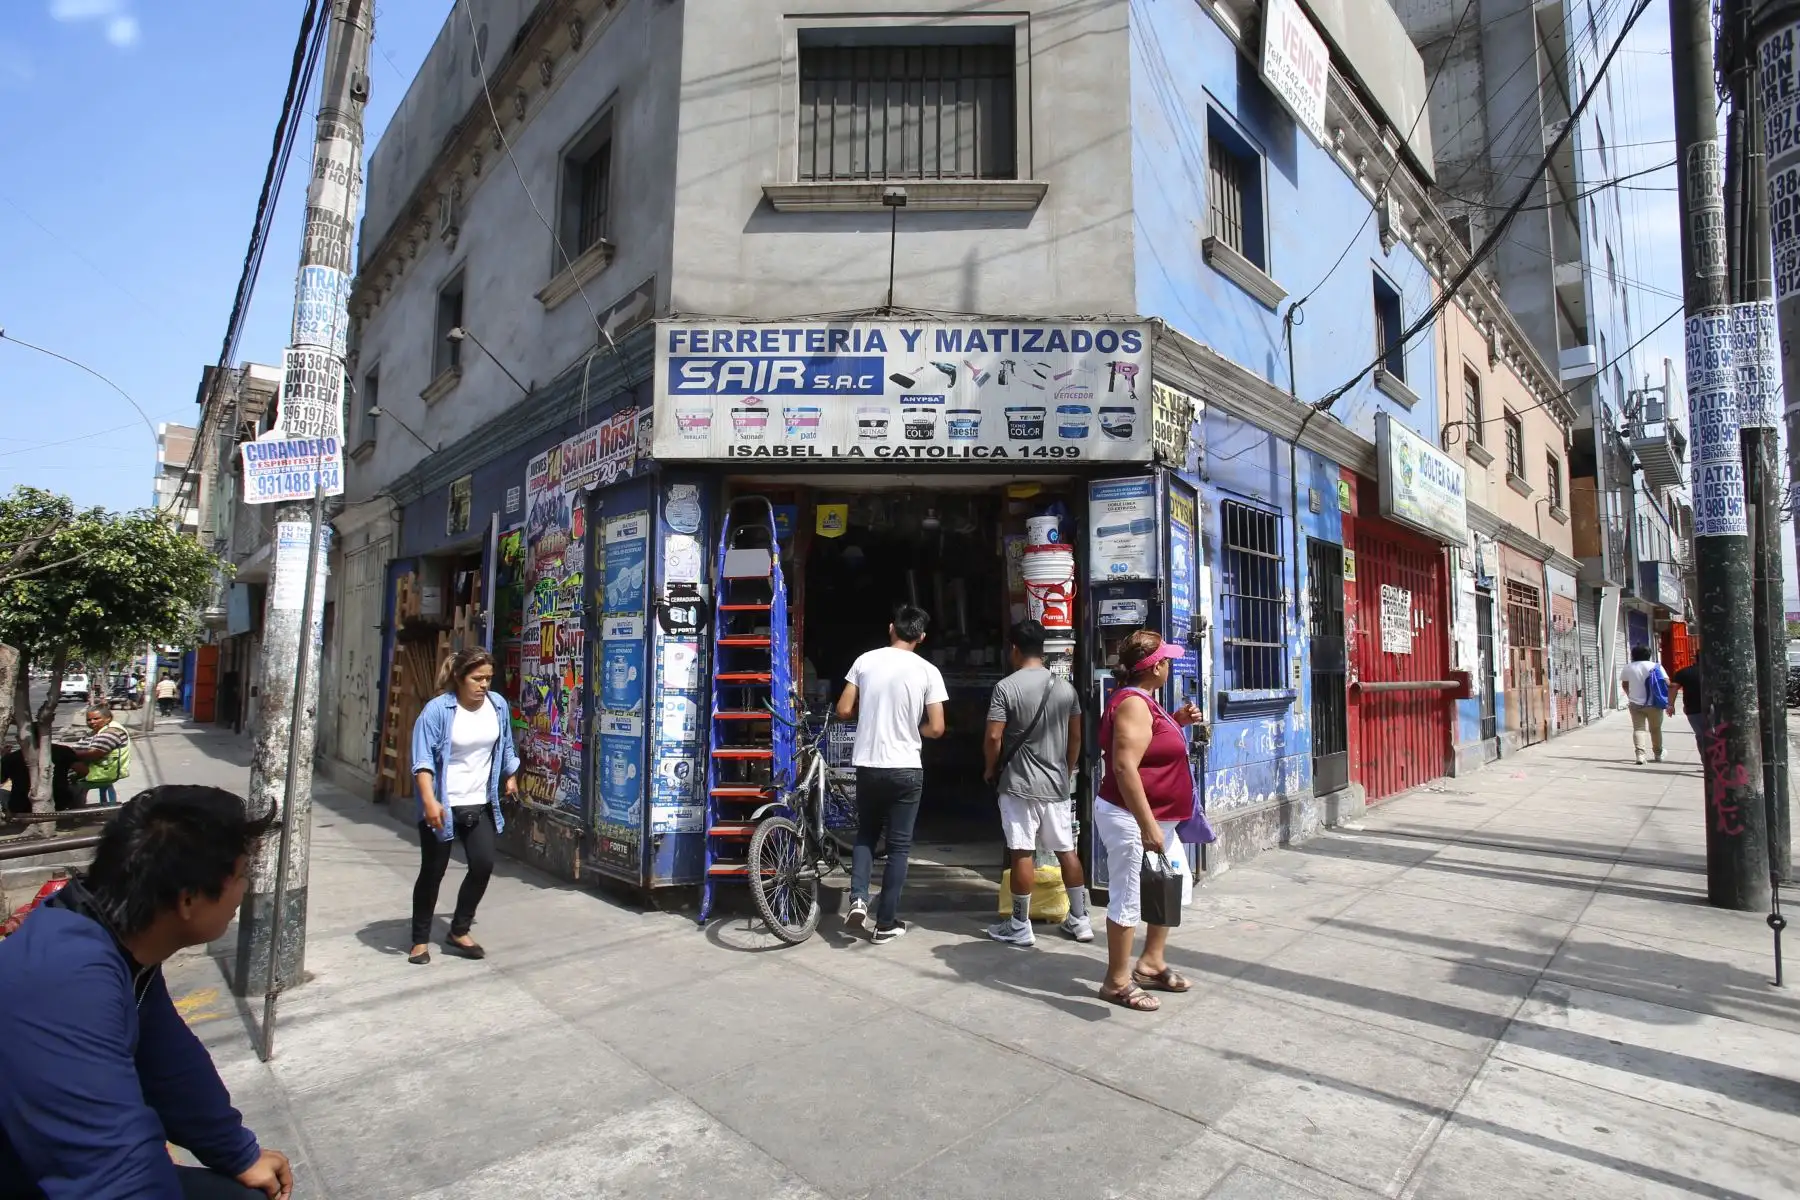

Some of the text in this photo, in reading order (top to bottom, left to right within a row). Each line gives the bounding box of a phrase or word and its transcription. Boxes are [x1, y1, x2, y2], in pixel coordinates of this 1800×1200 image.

[669, 328, 1142, 353] FERRETERIA Y MATIZADOS
[286, 353, 306, 369] 993
[285, 370, 327, 386] UNION
[677, 360, 809, 391] SAIR
[246, 437, 336, 461] CURANDERO
[562, 439, 597, 475] SANTA
[600, 417, 636, 457] ROSA
[728, 445, 1081, 458] ISABEL LA CATOLICA 1499
[541, 624, 554, 658] 14
